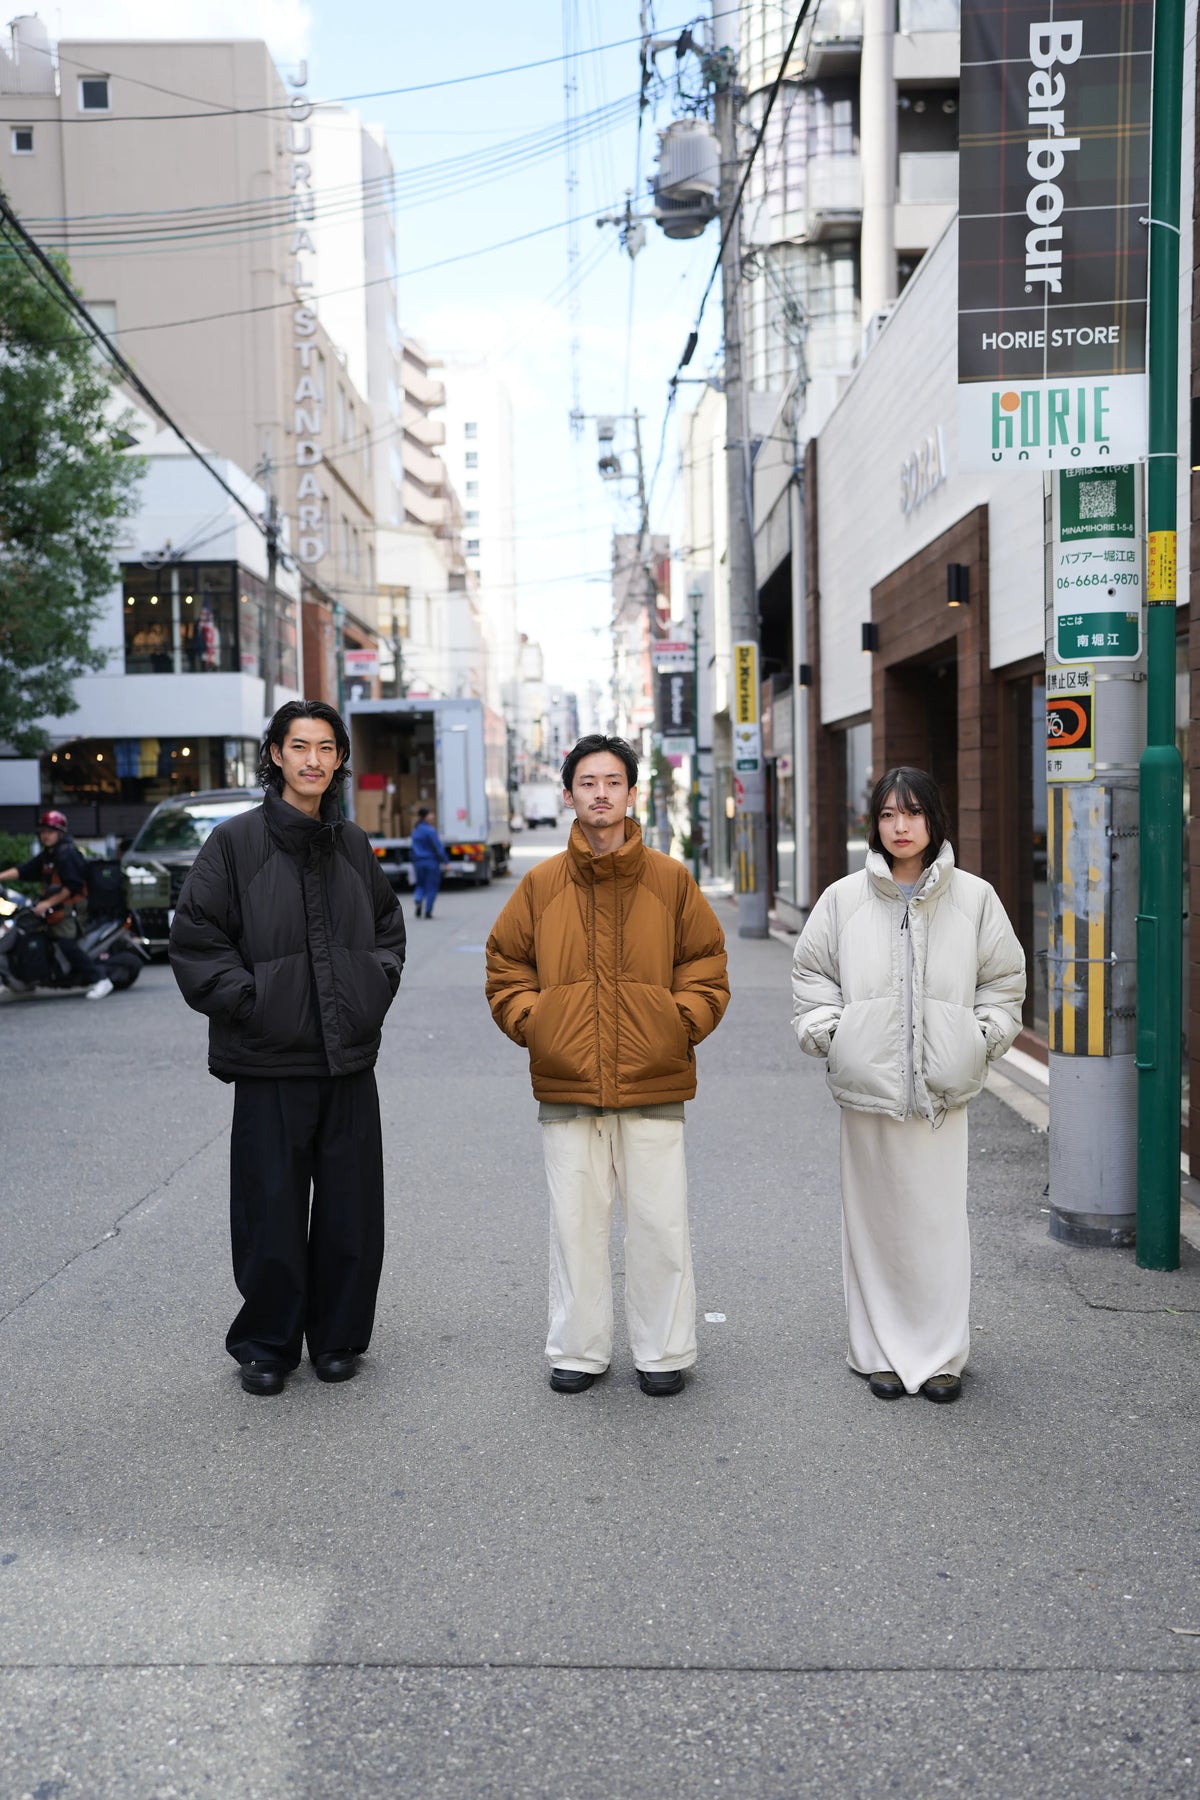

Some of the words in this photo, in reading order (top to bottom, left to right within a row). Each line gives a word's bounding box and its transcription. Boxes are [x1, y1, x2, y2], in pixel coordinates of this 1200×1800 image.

[287, 59, 316, 288] JOURNAL
[982, 329, 1045, 351] HORIE
[1051, 325, 1120, 347] STORE
[294, 307, 326, 564] STANDARD
[1061, 523, 1116, 536] MINAMIHORIE
[1060, 549, 1136, 566] バブアー堀江店
[1056, 573, 1140, 590] 06-6684-9870
[1059, 615, 1084, 627] ここは
[1047, 671, 1089, 692] 禁止区域
